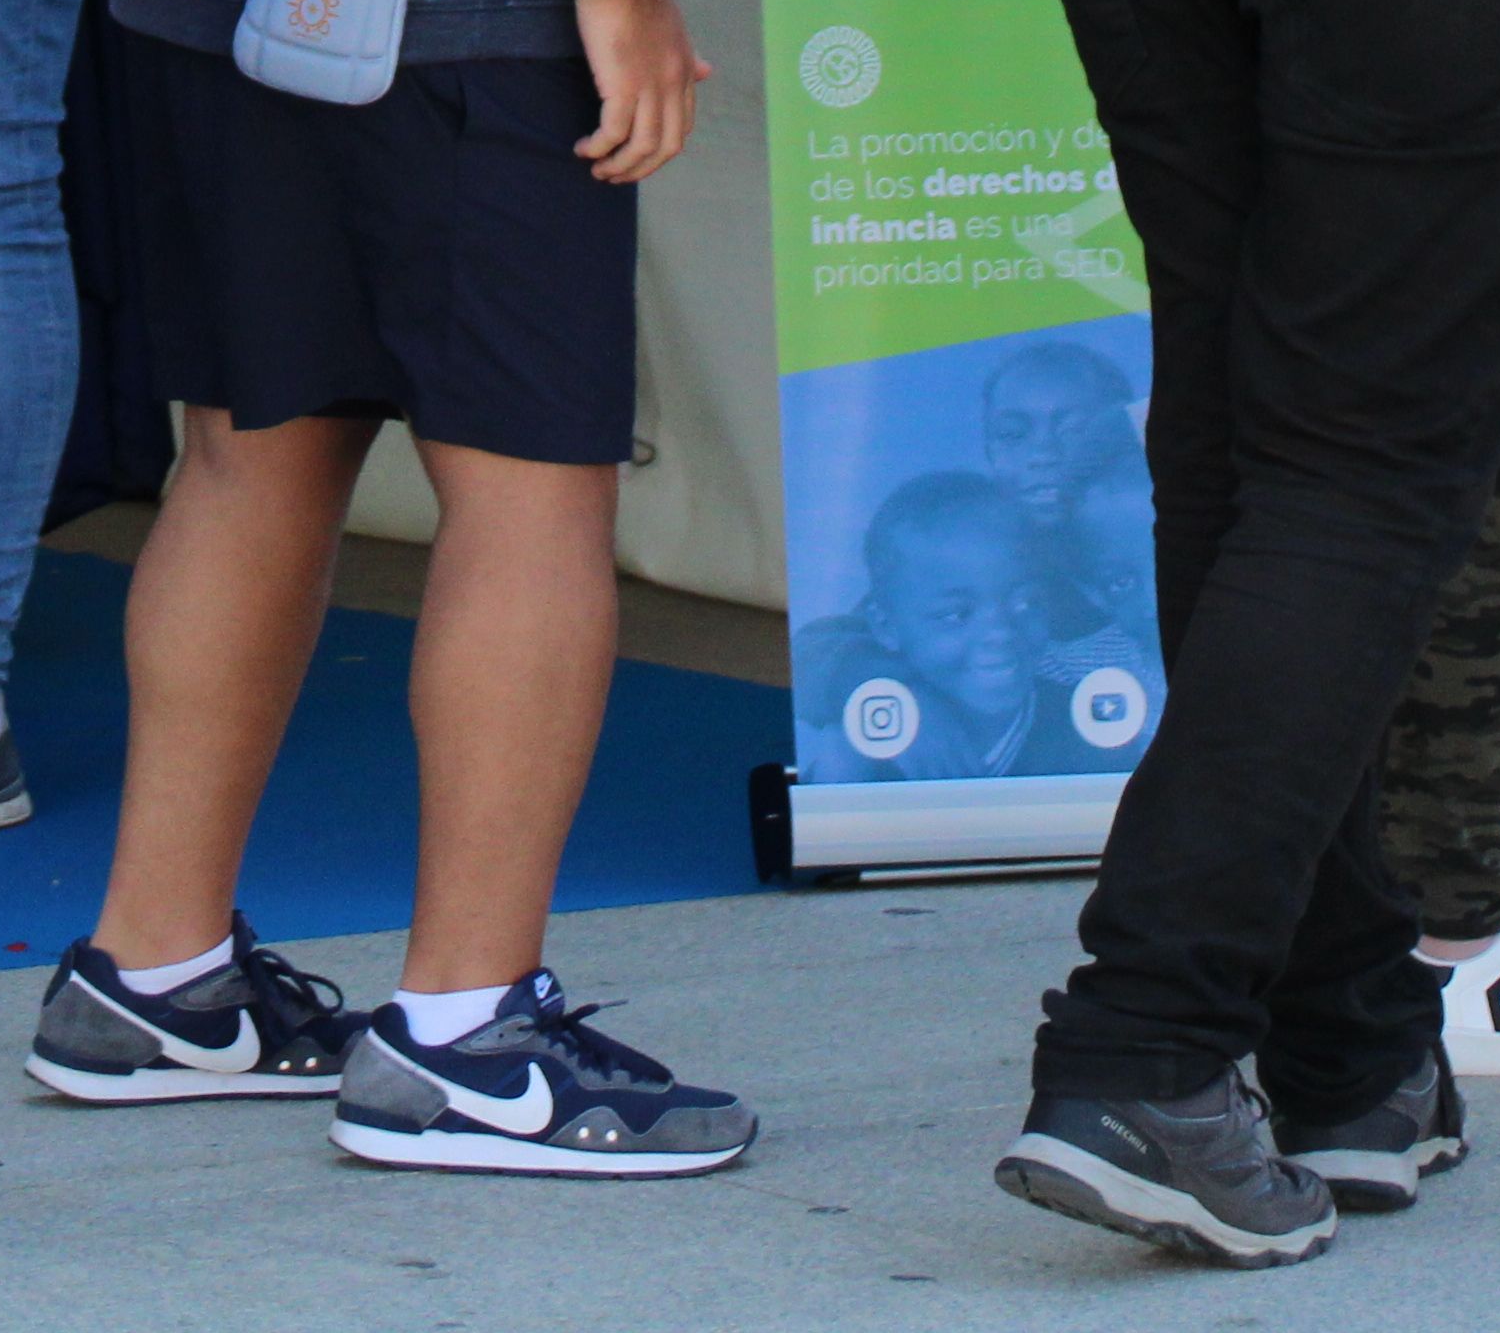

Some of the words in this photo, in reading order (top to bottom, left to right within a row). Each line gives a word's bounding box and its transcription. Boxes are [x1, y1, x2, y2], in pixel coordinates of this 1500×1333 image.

[808, 130, 849, 160] La
[860, 123, 1036, 165] promoción
[1042, 128, 1064, 159] y
[809, 171, 855, 202] de
[865, 169, 915, 200] los
[922, 164, 1087, 198] derechos
[811, 210, 957, 245] infancia
[965, 214, 1001, 239] es
[1012, 212, 1073, 238] una
[814, 253, 963, 298] prioridad
[972, 255, 1045, 291] para
